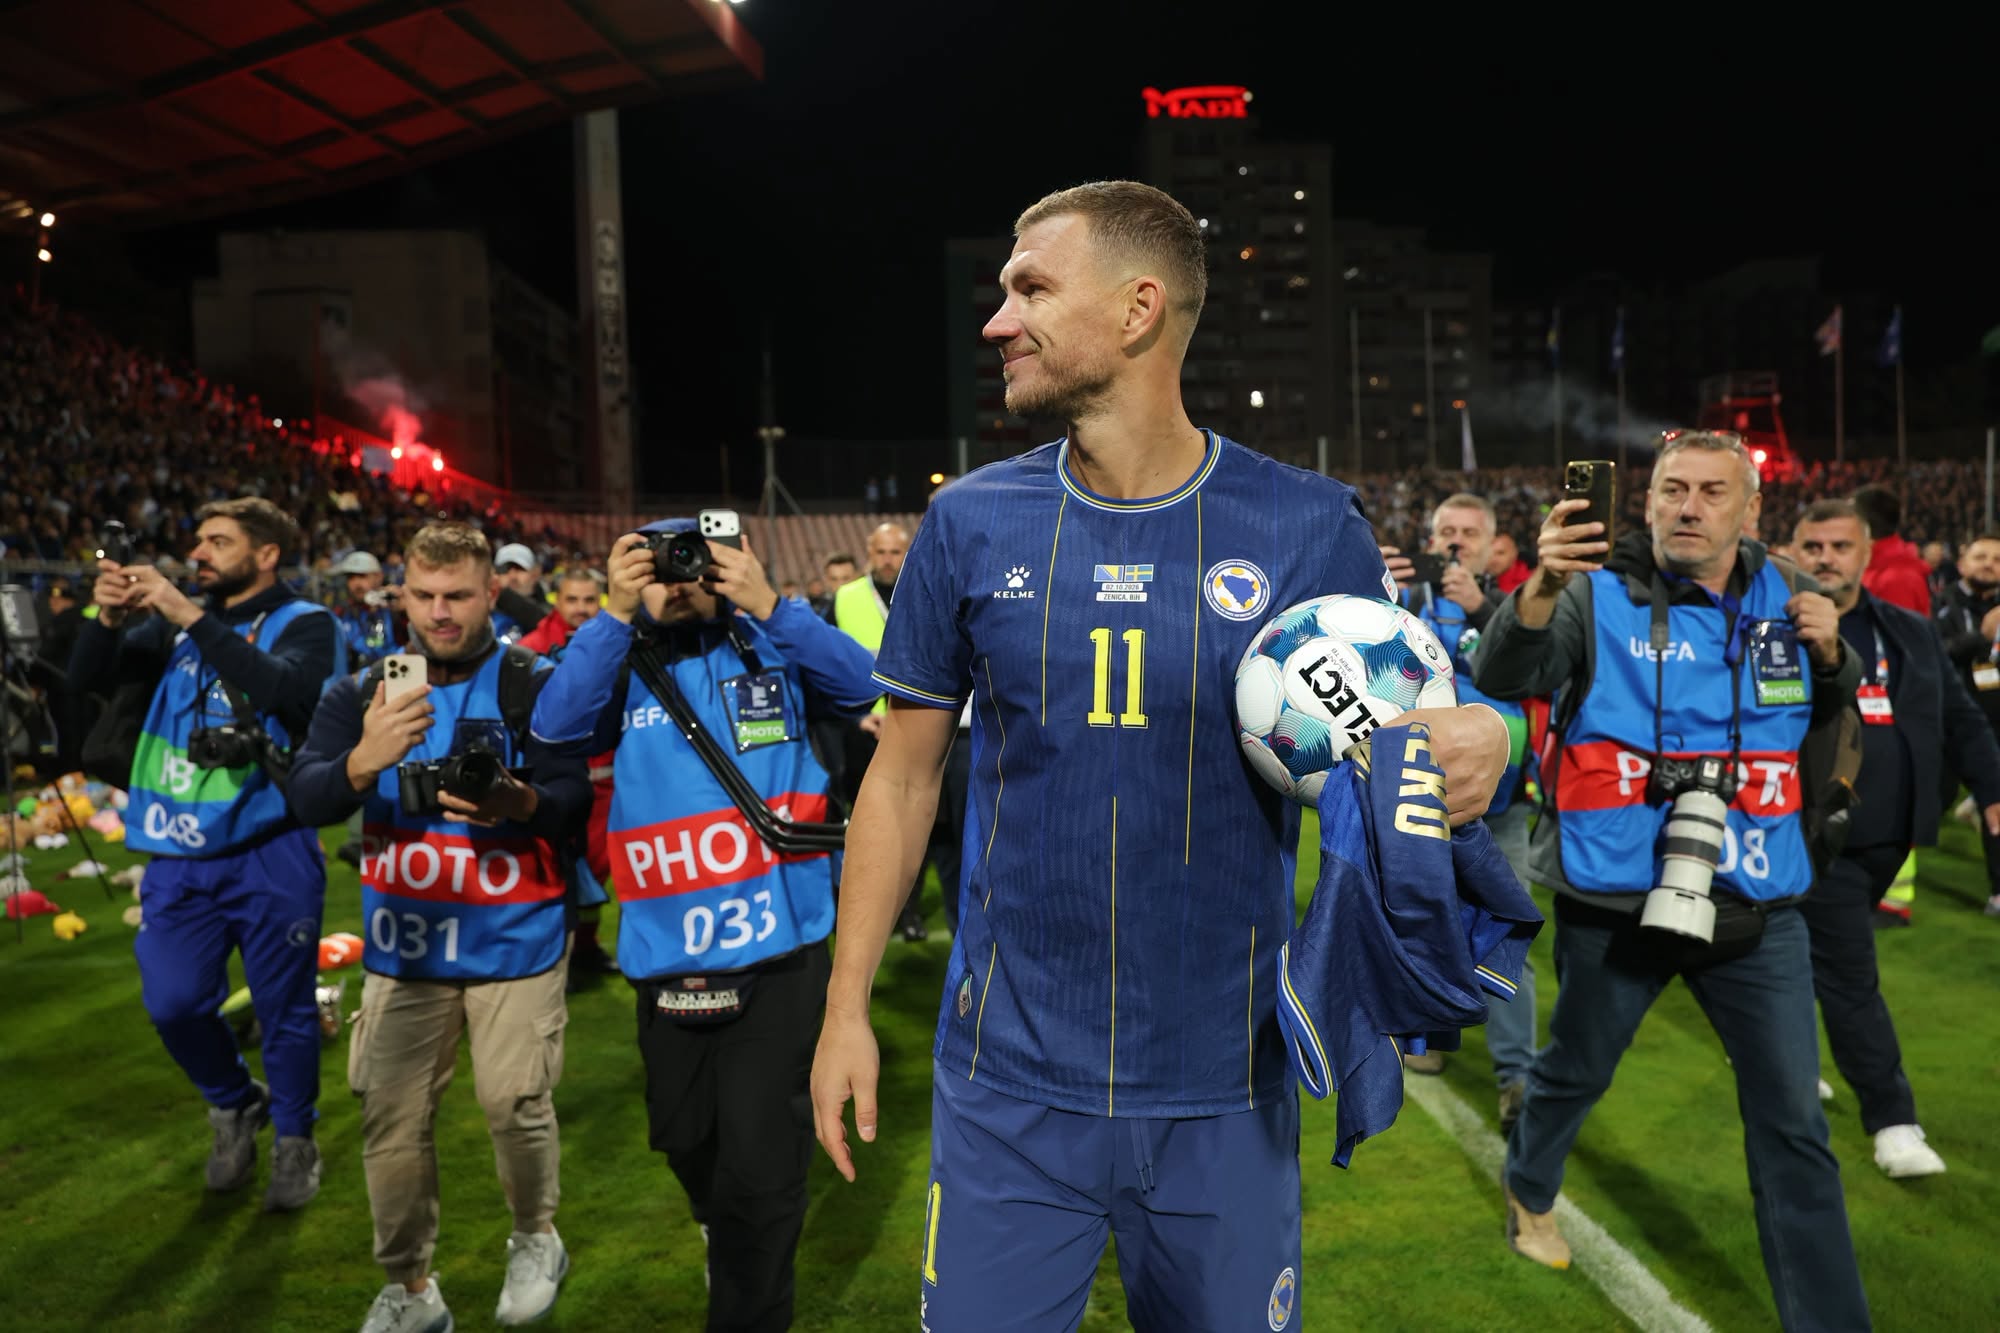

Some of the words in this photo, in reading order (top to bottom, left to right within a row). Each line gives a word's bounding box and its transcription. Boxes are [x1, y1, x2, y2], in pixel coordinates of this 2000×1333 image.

[993, 590, 1036, 599] KELME
[1087, 627, 1149, 729] 11
[1298, 655, 1381, 744] ELECT
[1394, 722, 1451, 841] EKO
[624, 804, 794, 889] PHO
[371, 907, 460, 963] 031
